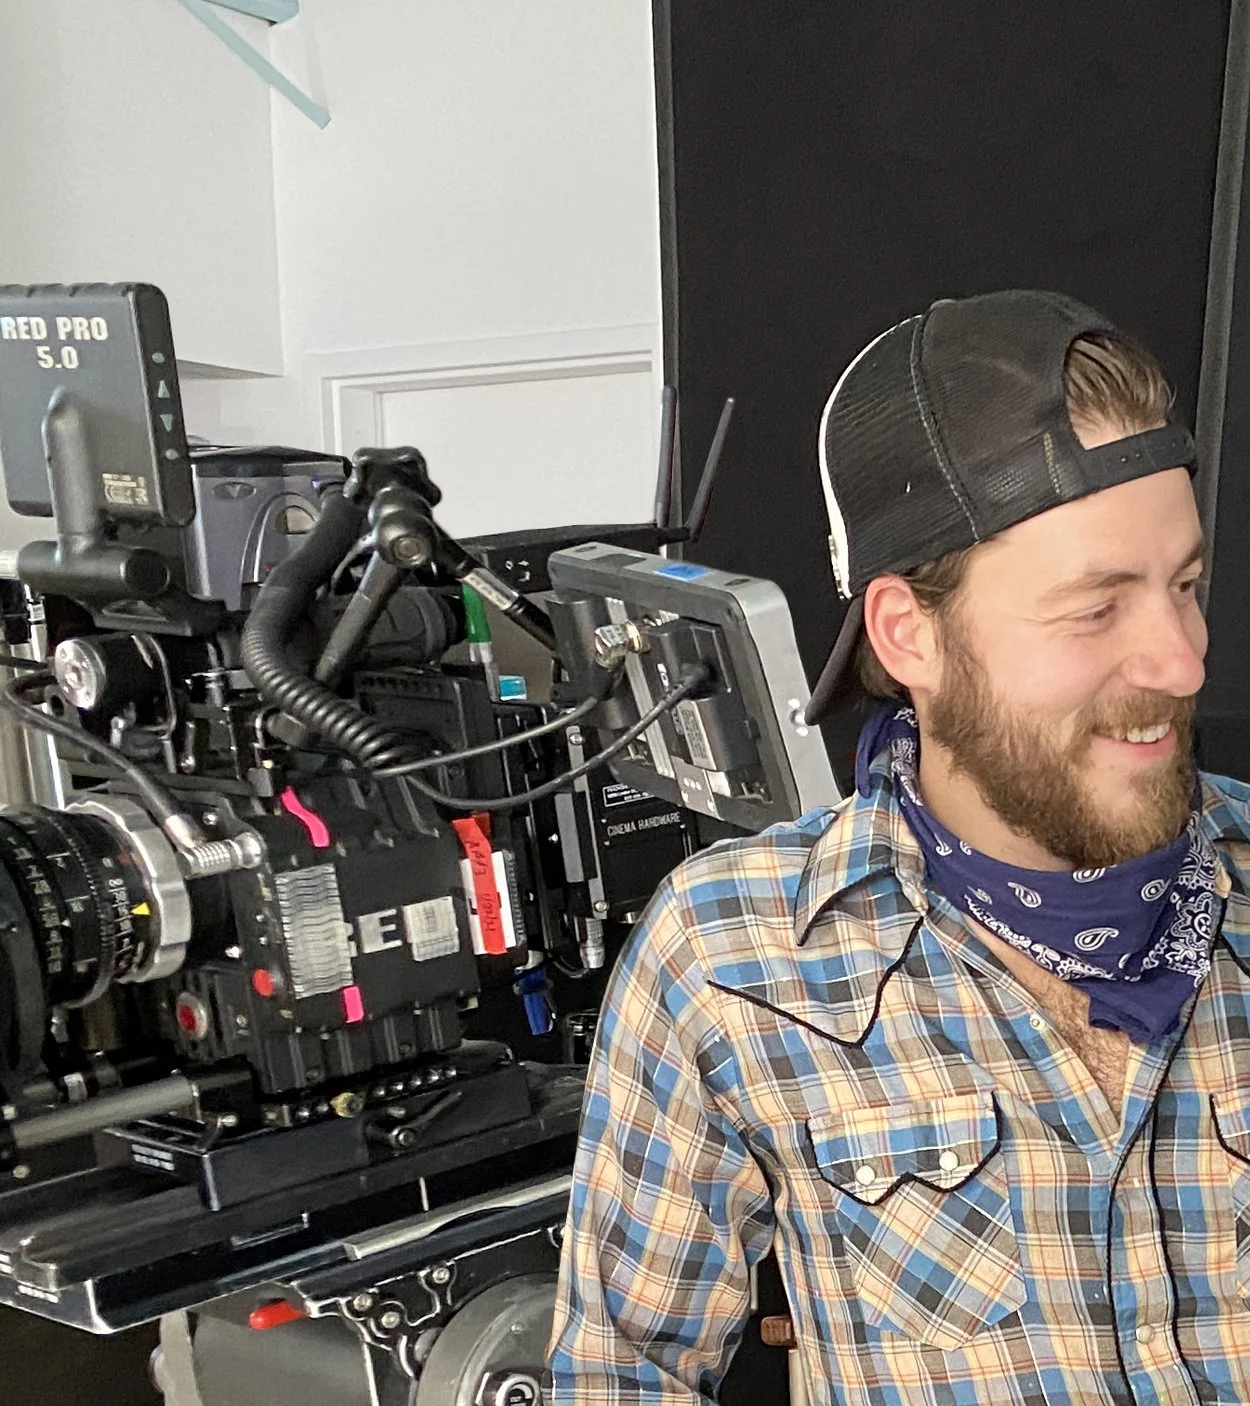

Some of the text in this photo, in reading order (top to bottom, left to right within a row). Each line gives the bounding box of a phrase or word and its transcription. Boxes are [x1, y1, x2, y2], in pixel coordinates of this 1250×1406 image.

[0, 316, 109, 341] RED PRO
[36, 345, 79, 369] 5.0
[606, 811, 681, 837] CINEMA HARDWARE
